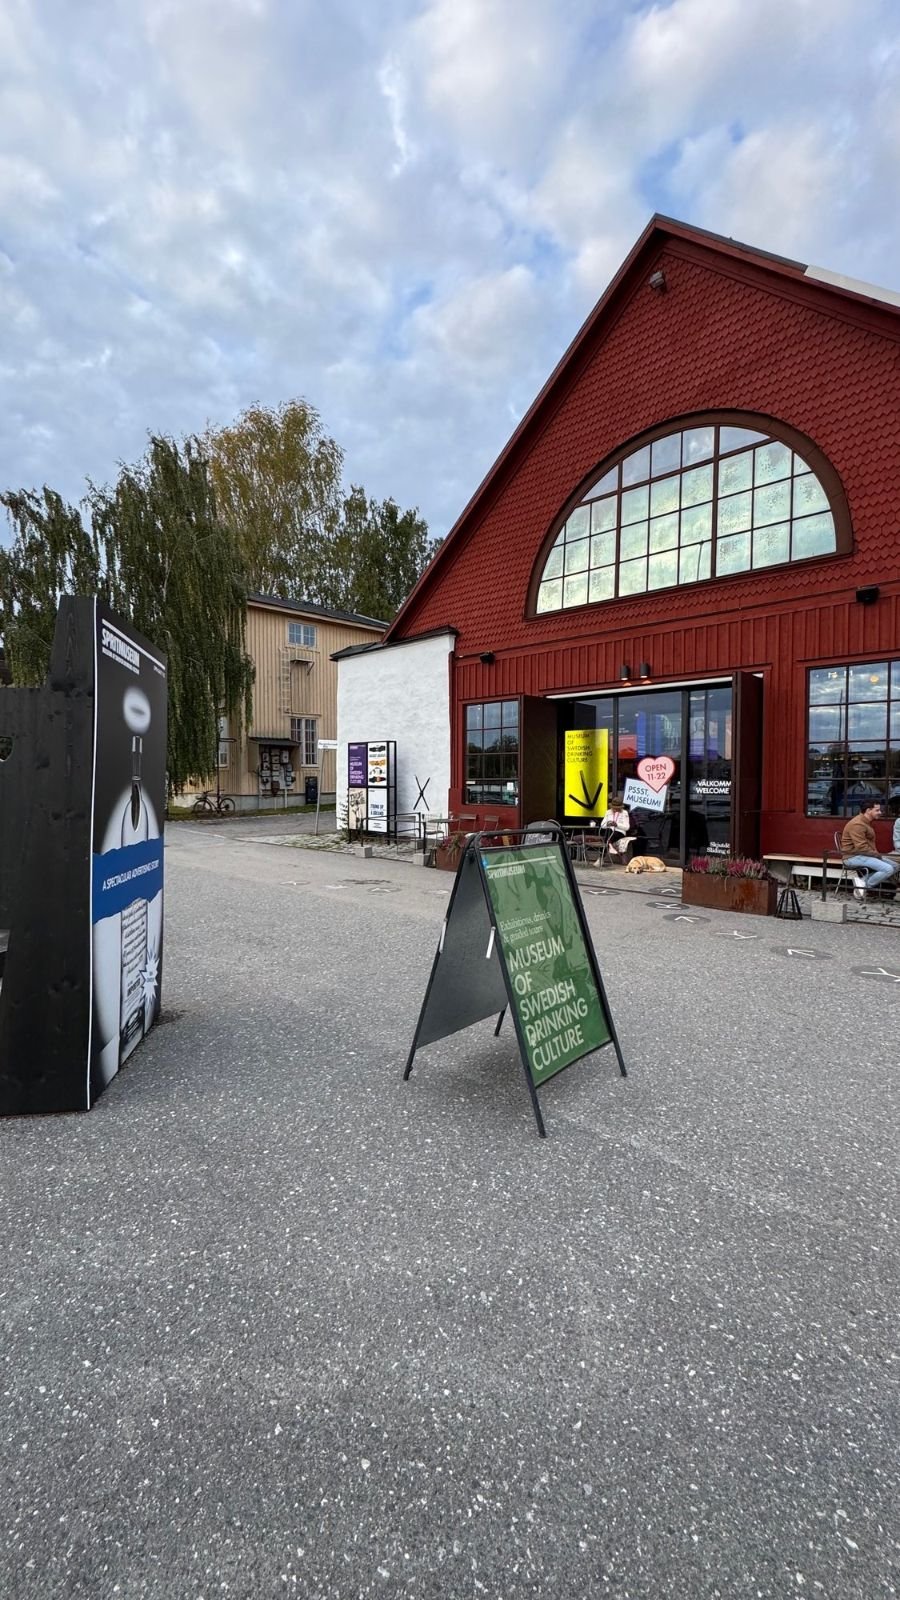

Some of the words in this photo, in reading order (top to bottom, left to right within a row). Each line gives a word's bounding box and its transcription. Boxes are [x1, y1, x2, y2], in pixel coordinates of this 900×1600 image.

[645, 763, 667, 772] OPEN
[626, 794, 662, 807] MUSEUM!
[628, 786, 649, 797] PSSST,
[102, 880, 107, 891] A
[107, 870, 131, 889] SPECTACULAR
[534, 911, 552, 921] drinks
[503, 934, 509, 943] &
[509, 926, 529, 942] guided
[529, 925, 543, 935] tours
[508, 935, 565, 973] MUSEUM
[514, 971, 533, 995] OF
[519, 978, 577, 1021] SWEDISH
[525, 998, 588, 1047] DRINKING
[532, 1024, 584, 1071] CULTURE
